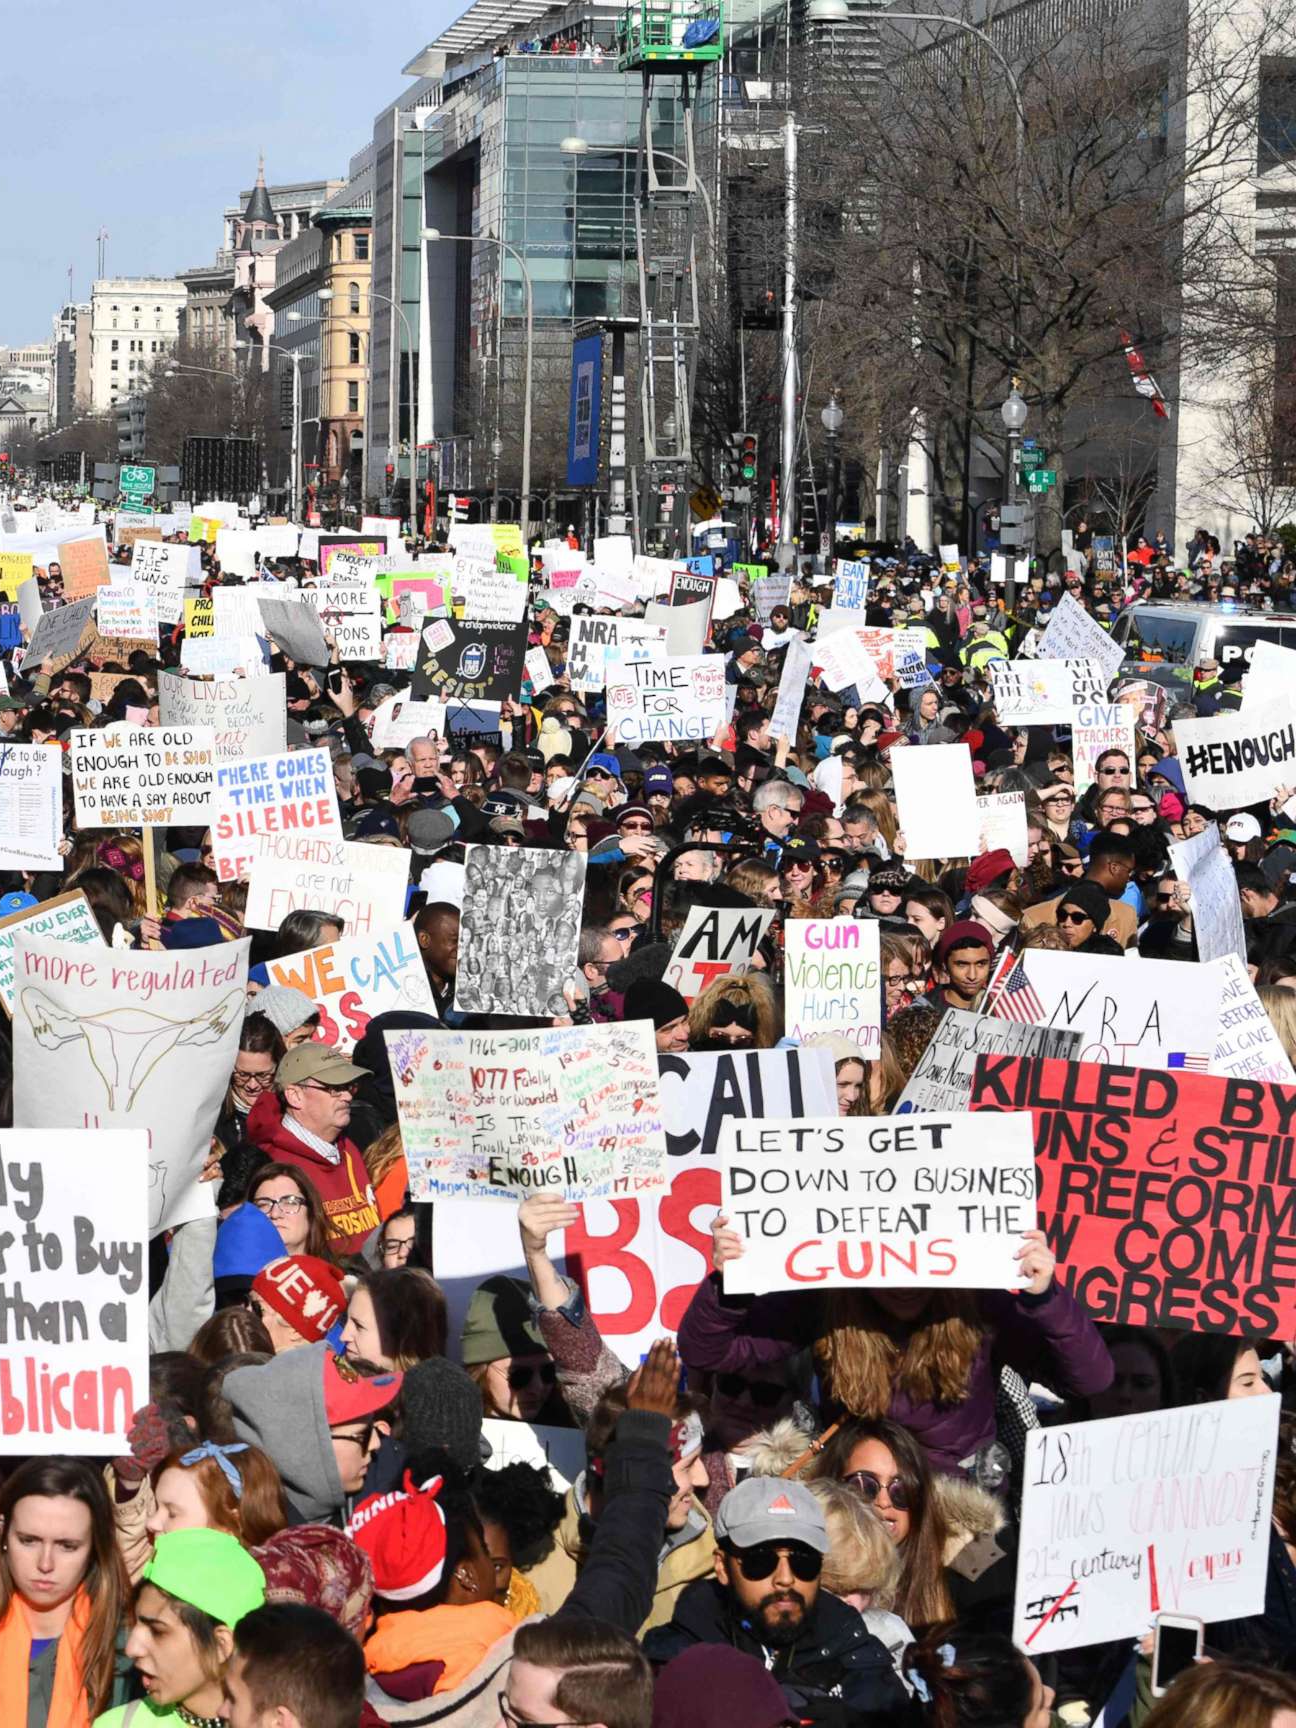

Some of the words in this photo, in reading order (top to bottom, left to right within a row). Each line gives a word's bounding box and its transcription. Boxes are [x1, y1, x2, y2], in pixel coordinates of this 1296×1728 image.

[1028, 473, 1036, 482] 4
[133, 572, 170, 585] GUNS
[136, 559, 162, 573] THE
[300, 592, 318, 605] NO
[326, 592, 368, 605] MORE
[674, 576, 711, 593] ENOUGH
[578, 620, 618, 646] NRA
[624, 660, 689, 688] TIME
[609, 688, 635, 705] VOTE
[642, 693, 684, 714] FOR
[1078, 705, 1123, 726] GIVE
[75, 733, 98, 750] IF
[103, 733, 125, 749] WE
[129, 732, 156, 748] ARE
[163, 731, 194, 746] OLD
[1185, 723, 1296, 778] #ENOUGH
[76, 752, 141, 773] ENOUGH
[143, 752, 162, 768] TO
[165, 749, 180, 766] BE
[182, 749, 212, 766] SHOT
[229, 783, 276, 807] TIME
[281, 776, 326, 800] WHEN
[996, 791, 1025, 806] AGAIN
[215, 798, 335, 840] SILENCE
[295, 872, 326, 890] are
[329, 873, 354, 894] not
[28, 918, 56, 936] YOU
[56, 904, 90, 930] EVER
[805, 923, 861, 950] Gun
[24, 950, 98, 988] more
[111, 952, 241, 1001] regulated
[271, 945, 349, 999] WE
[352, 931, 418, 993] CALL
[787, 955, 878, 990] Violence
[801, 992, 860, 1022] Hurts
[1048, 980, 1164, 1048] NRA
[469, 1037, 540, 1057] 1966-2018
[469, 1066, 508, 1091] 1077
[512, 1067, 552, 1092] Fatally
[970, 1053, 1178, 1120] KILLED
[1220, 1078, 1296, 1135] BY
[471, 1134, 512, 1163] Finally
[735, 1126, 845, 1154] LET'S
[868, 1124, 952, 1153] GET
[1146, 1118, 1180, 1172] &
[488, 1156, 578, 1188] ENOUGH
[730, 1166, 849, 1195] DOWN
[861, 1169, 897, 1193] TO
[914, 1167, 1035, 1201] BUSINESS
[1056, 1163, 1296, 1236] REFORM
[740, 1208, 788, 1238] TO
[816, 1203, 931, 1236] DEFEAT
[957, 1204, 1023, 1236] THE
[22, 1220, 64, 1273] to
[73, 1215, 143, 1295] Buy
[564, 1166, 721, 1336] BS
[784, 1238, 958, 1283] GUNS
[1114, 1220, 1296, 1288] COME
[99, 1302, 128, 1342] a
[1032, 1431, 1093, 1487] 18th
[1112, 1409, 1224, 1486] century
[1049, 1490, 1106, 1545] laws
[1128, 1466, 1261, 1537] CANNOT
[1070, 1547, 1143, 1581] century
